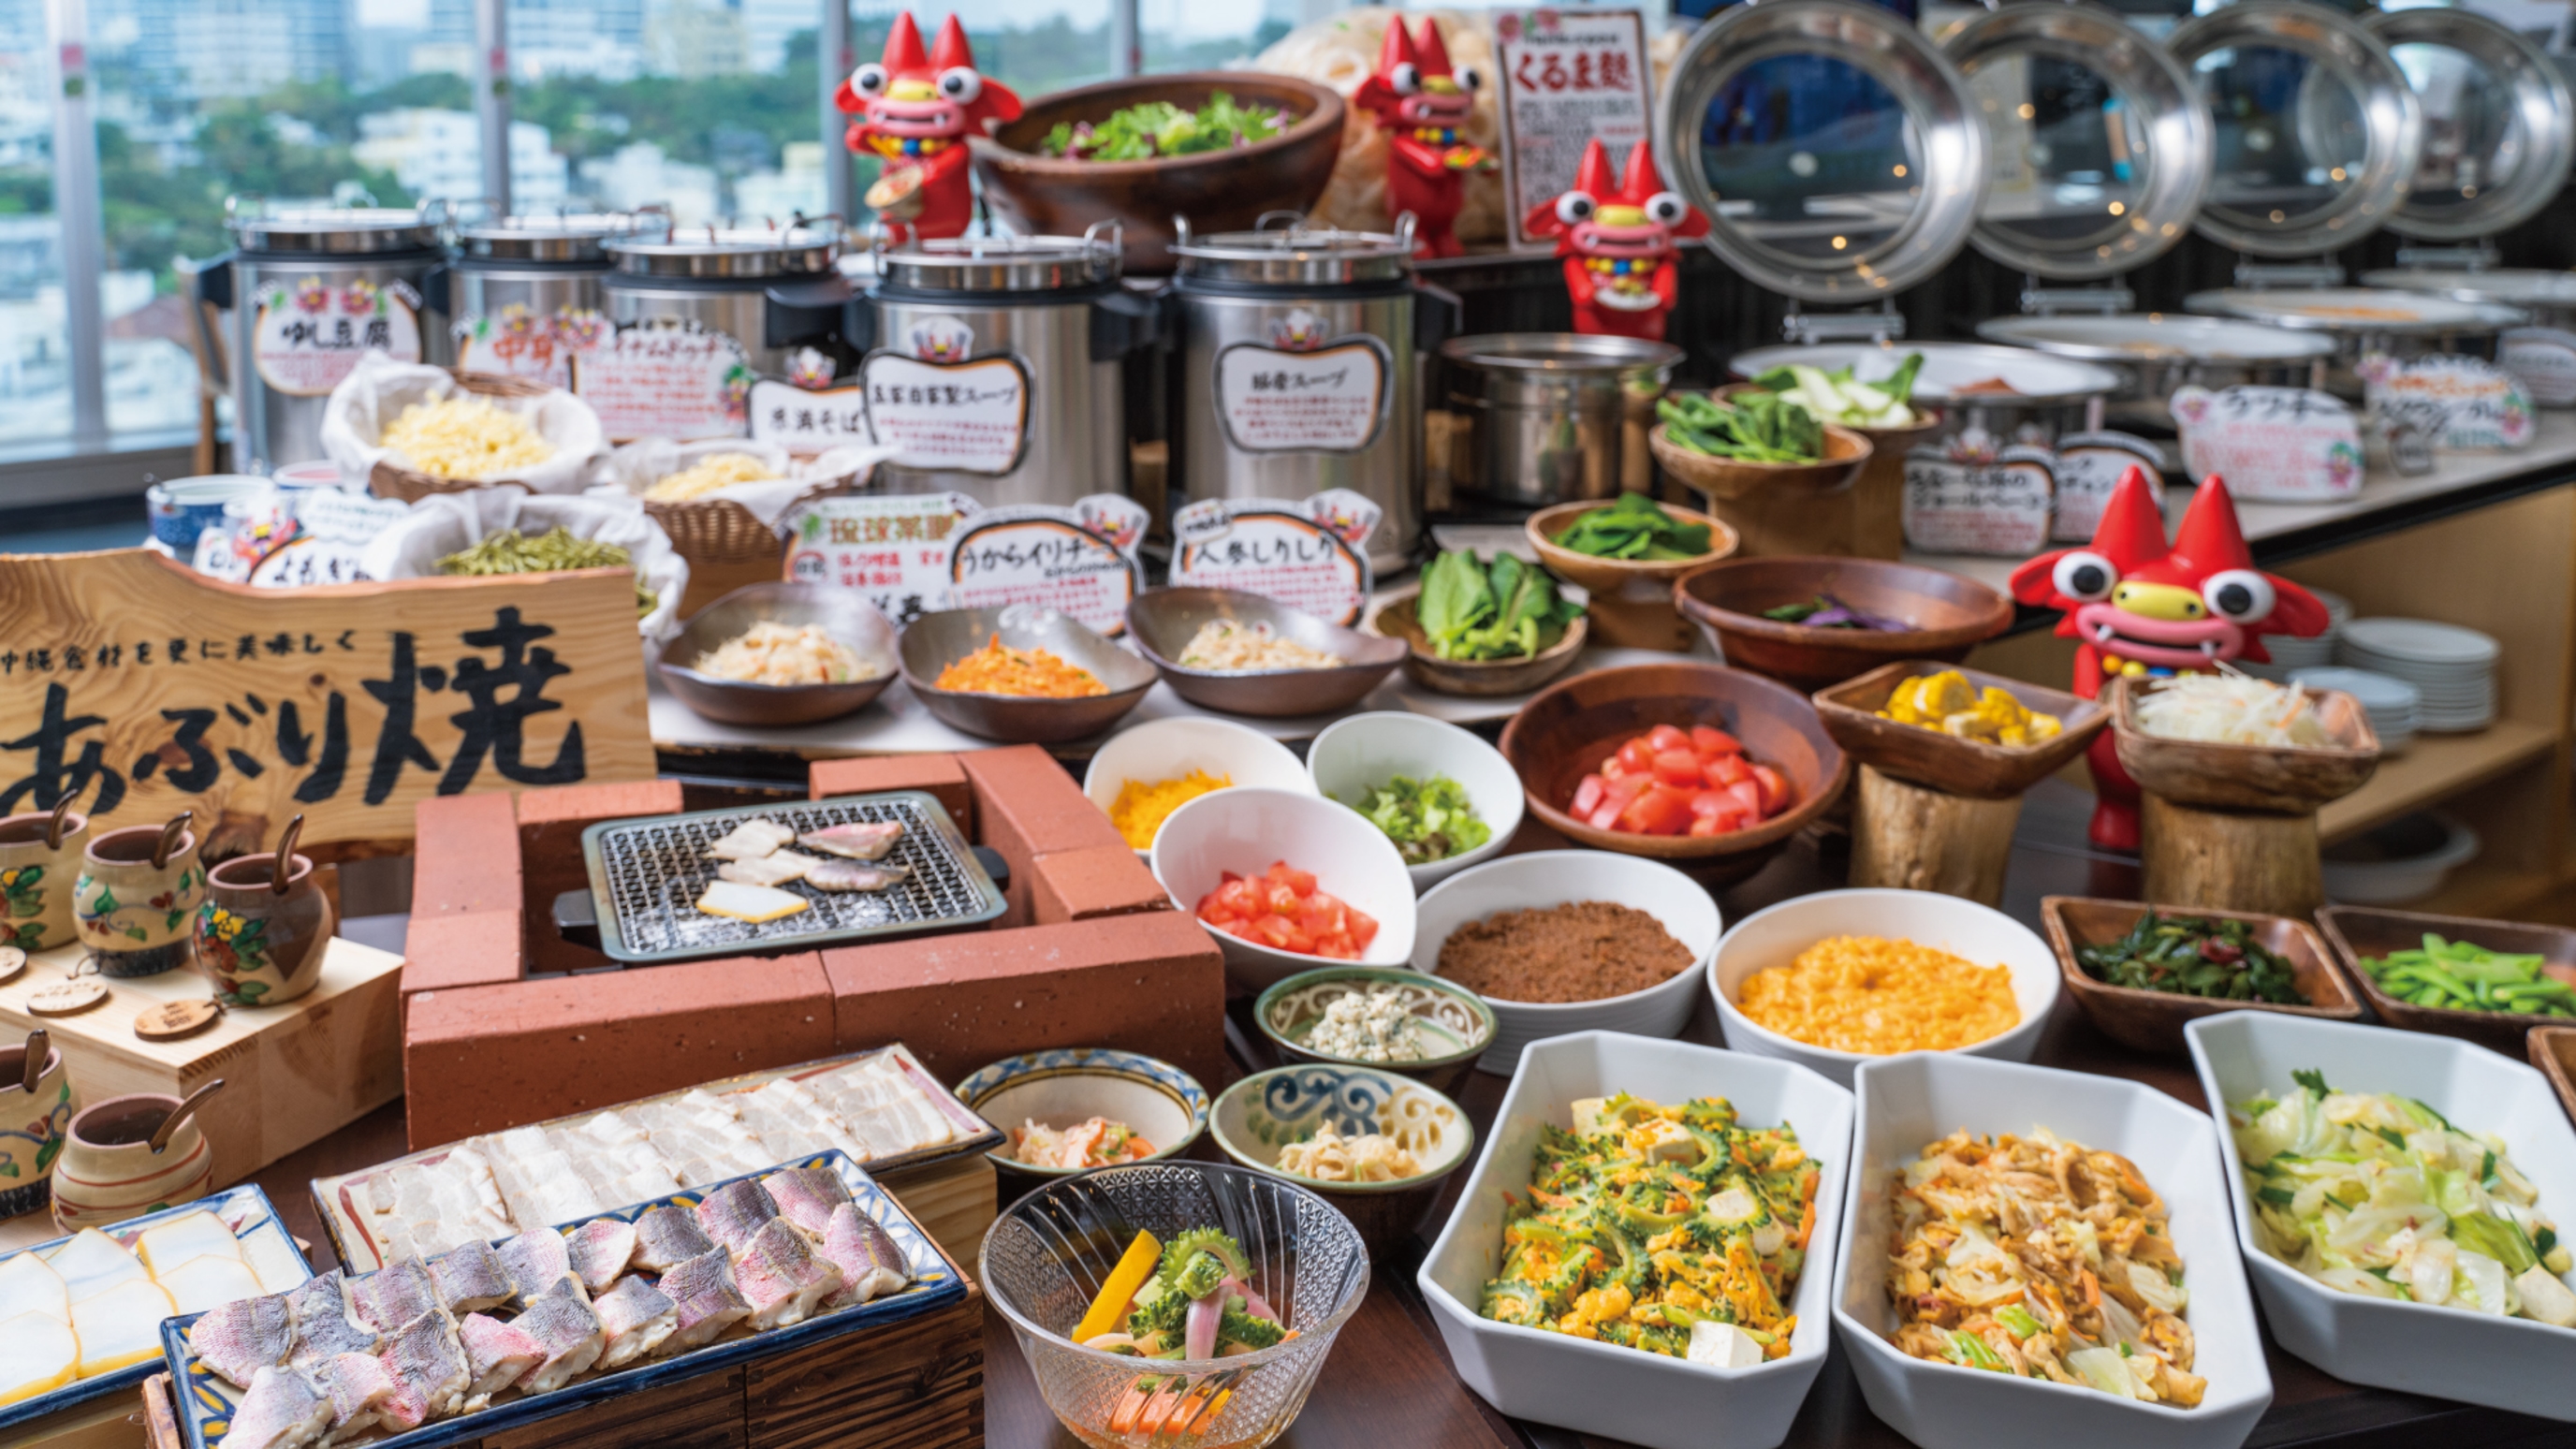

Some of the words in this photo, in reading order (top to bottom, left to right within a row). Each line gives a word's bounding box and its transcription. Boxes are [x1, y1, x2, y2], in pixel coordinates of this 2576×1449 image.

[1515, 51, 1633, 92] くるま麩
[1195, 536, 1334, 564] 人参しりしり
